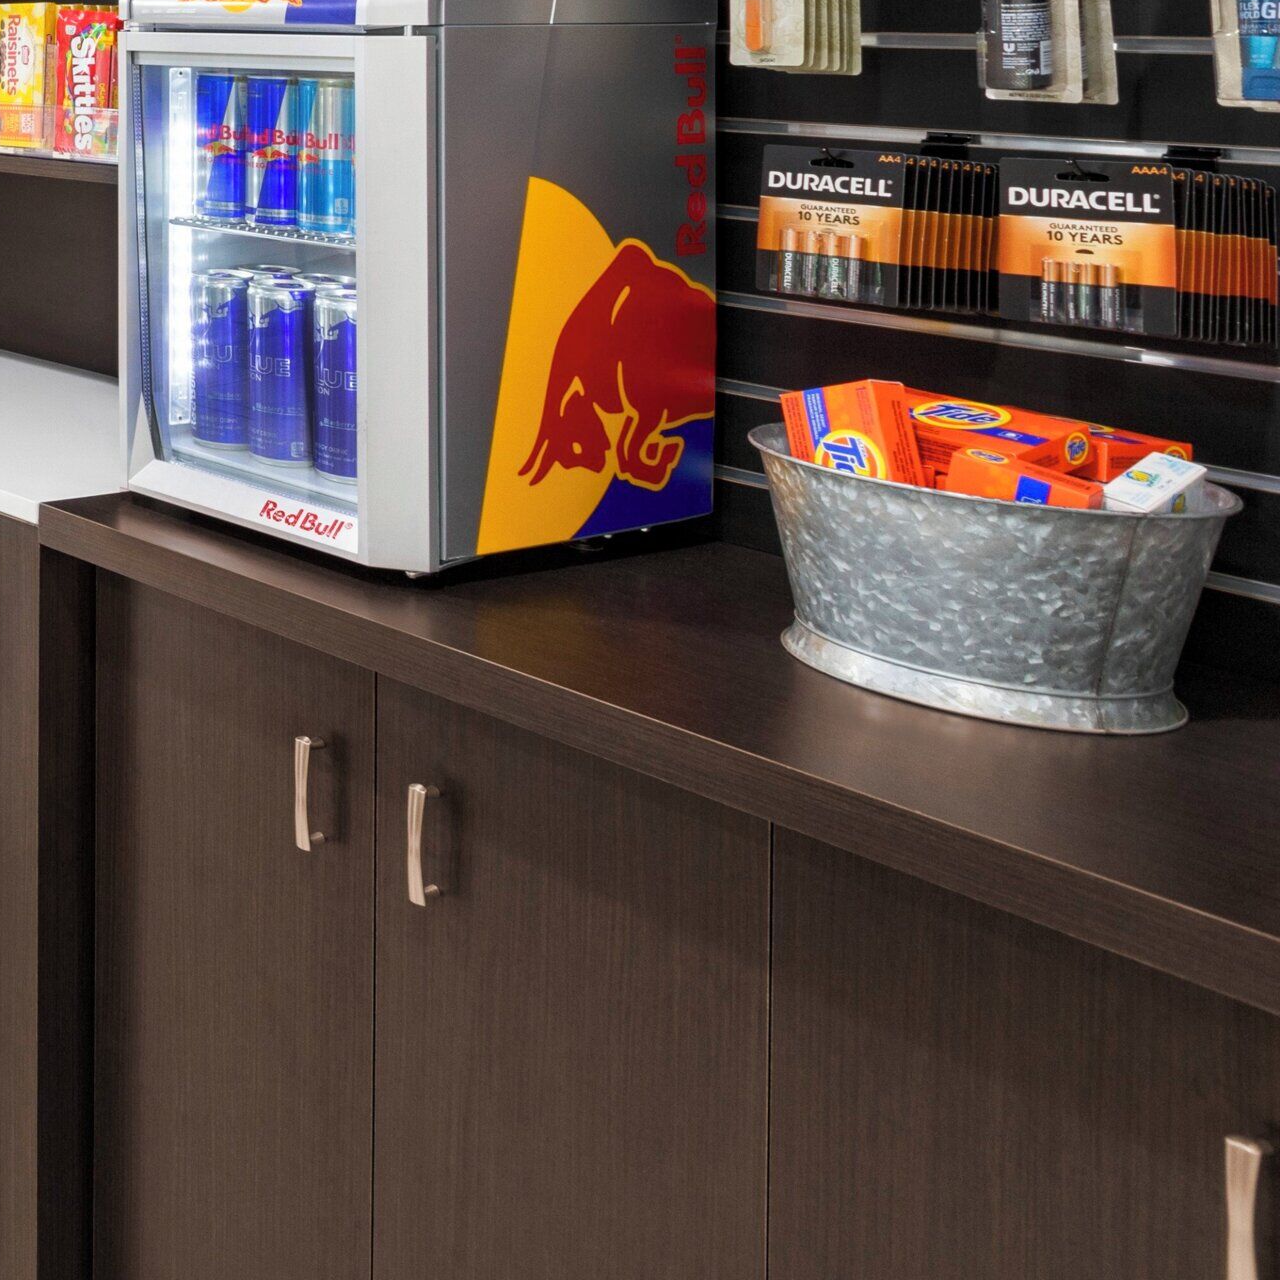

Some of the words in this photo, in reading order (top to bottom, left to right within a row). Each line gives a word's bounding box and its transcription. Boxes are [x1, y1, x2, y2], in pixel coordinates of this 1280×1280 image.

[7, 14, 21, 96] Raisinets
[71, 36, 96, 151] Skittles
[675, 47, 707, 145] Bull
[878, 154, 901, 163] AA4
[1131, 165, 1168, 175] AAA4
[768, 171, 892, 197] DURACELL
[673, 153, 707, 257] Red
[800, 203, 857, 214] GUARANTEED
[1008, 186, 1160, 213] DURACELL
[798, 211, 812, 220] 10
[816, 212, 860, 225] YEARS
[1049, 222, 1118, 233] GUARANTEED
[1046, 230, 1063, 241] 10
[1069, 231, 1123, 245] YEARS
[1068, 440, 1087, 459] Tide
[260, 500, 303, 526] Red
[301, 512, 344, 540] Bull
